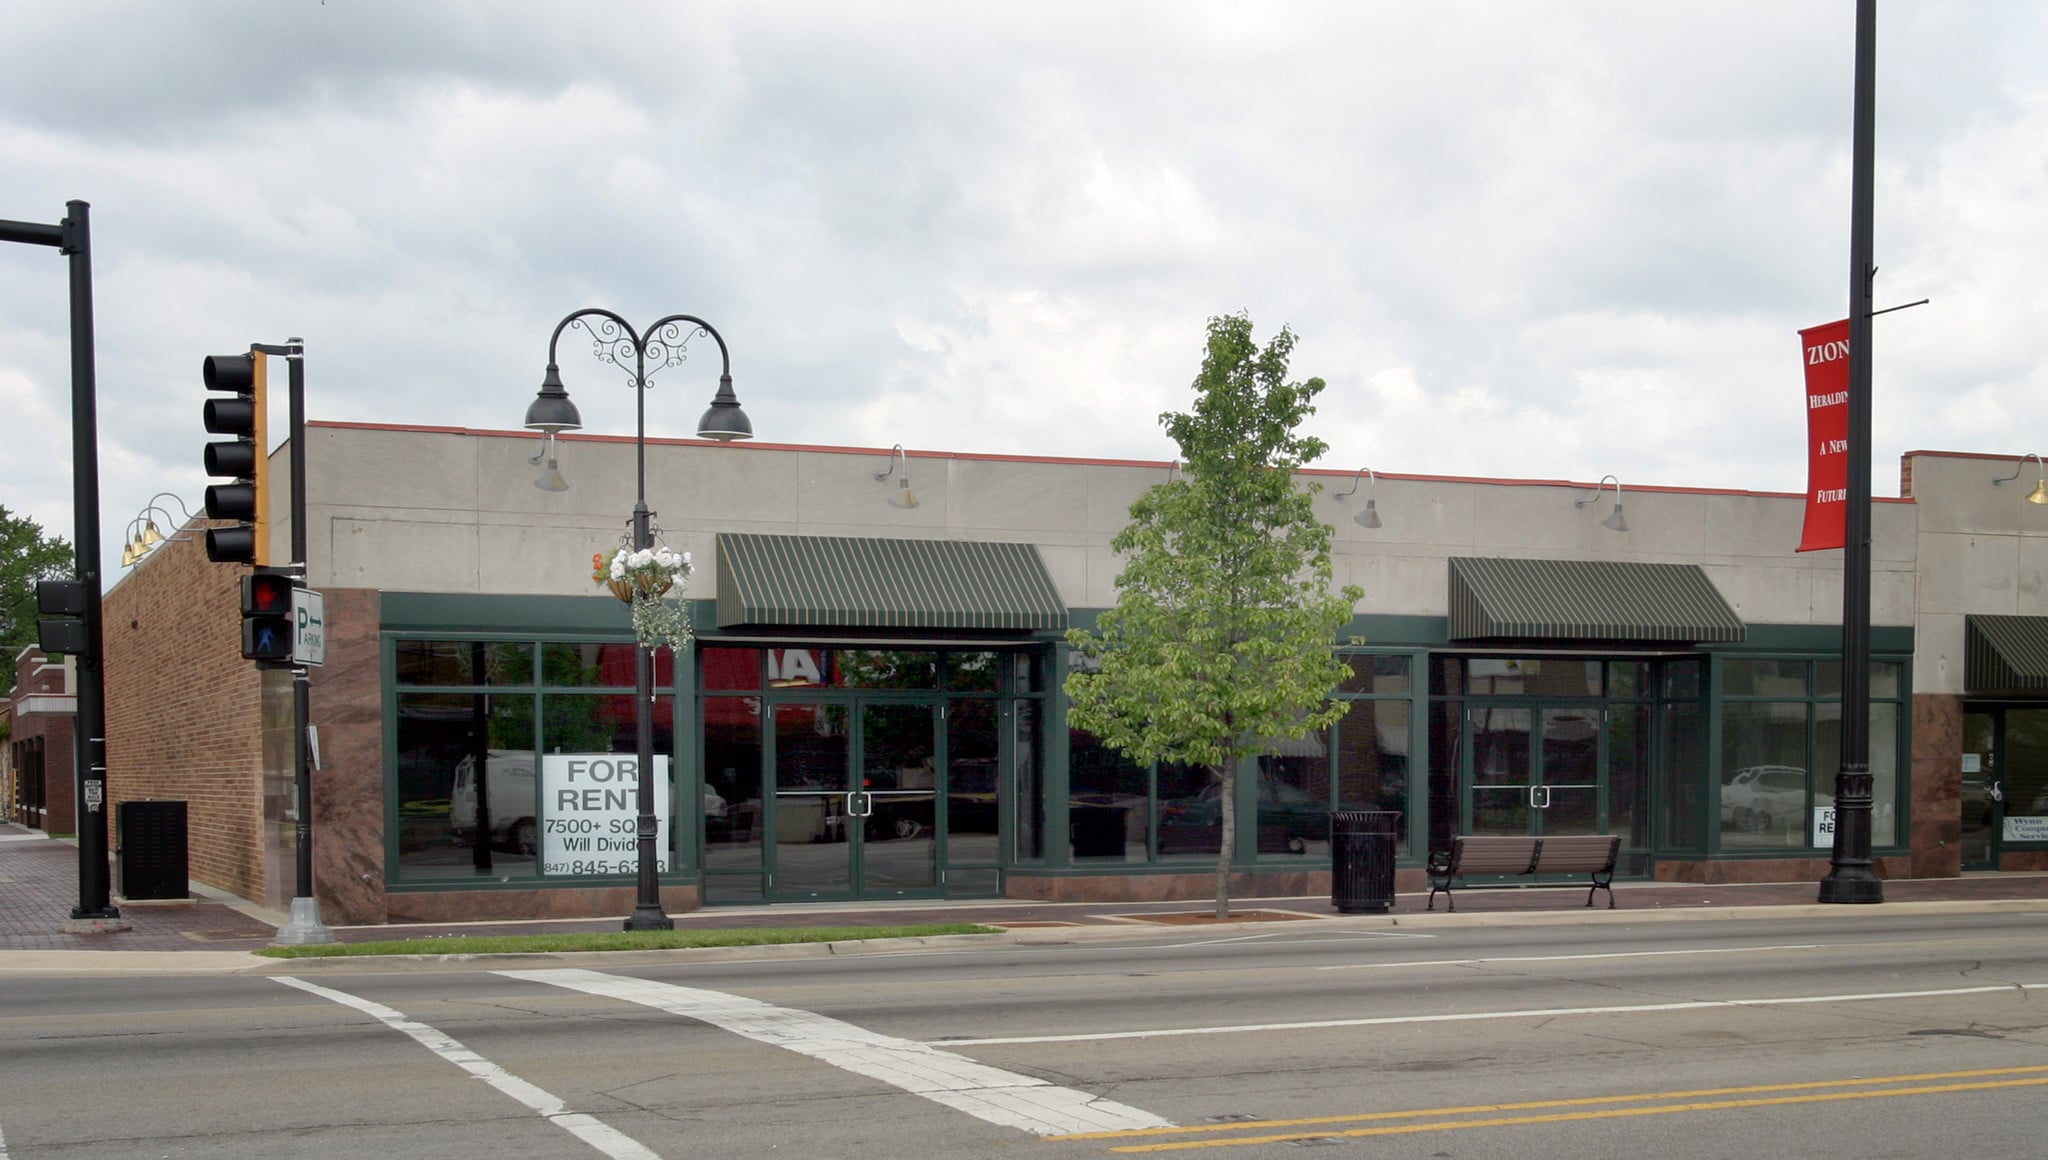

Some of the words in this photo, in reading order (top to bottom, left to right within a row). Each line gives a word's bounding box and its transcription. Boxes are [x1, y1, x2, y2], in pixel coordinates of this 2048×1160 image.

[1807, 339, 1849, 365] ZION
[1809, 391, 1848, 408] HERALDIN
[1819, 441, 1826, 455] A
[1829, 439, 1848, 454] NEW
[567, 760, 638, 782] FOR
[545, 818, 601, 833] 7500+
[563, 837, 590, 851] Will
[597, 837, 639, 851] Divid
[543, 862, 570, 873] 847)
